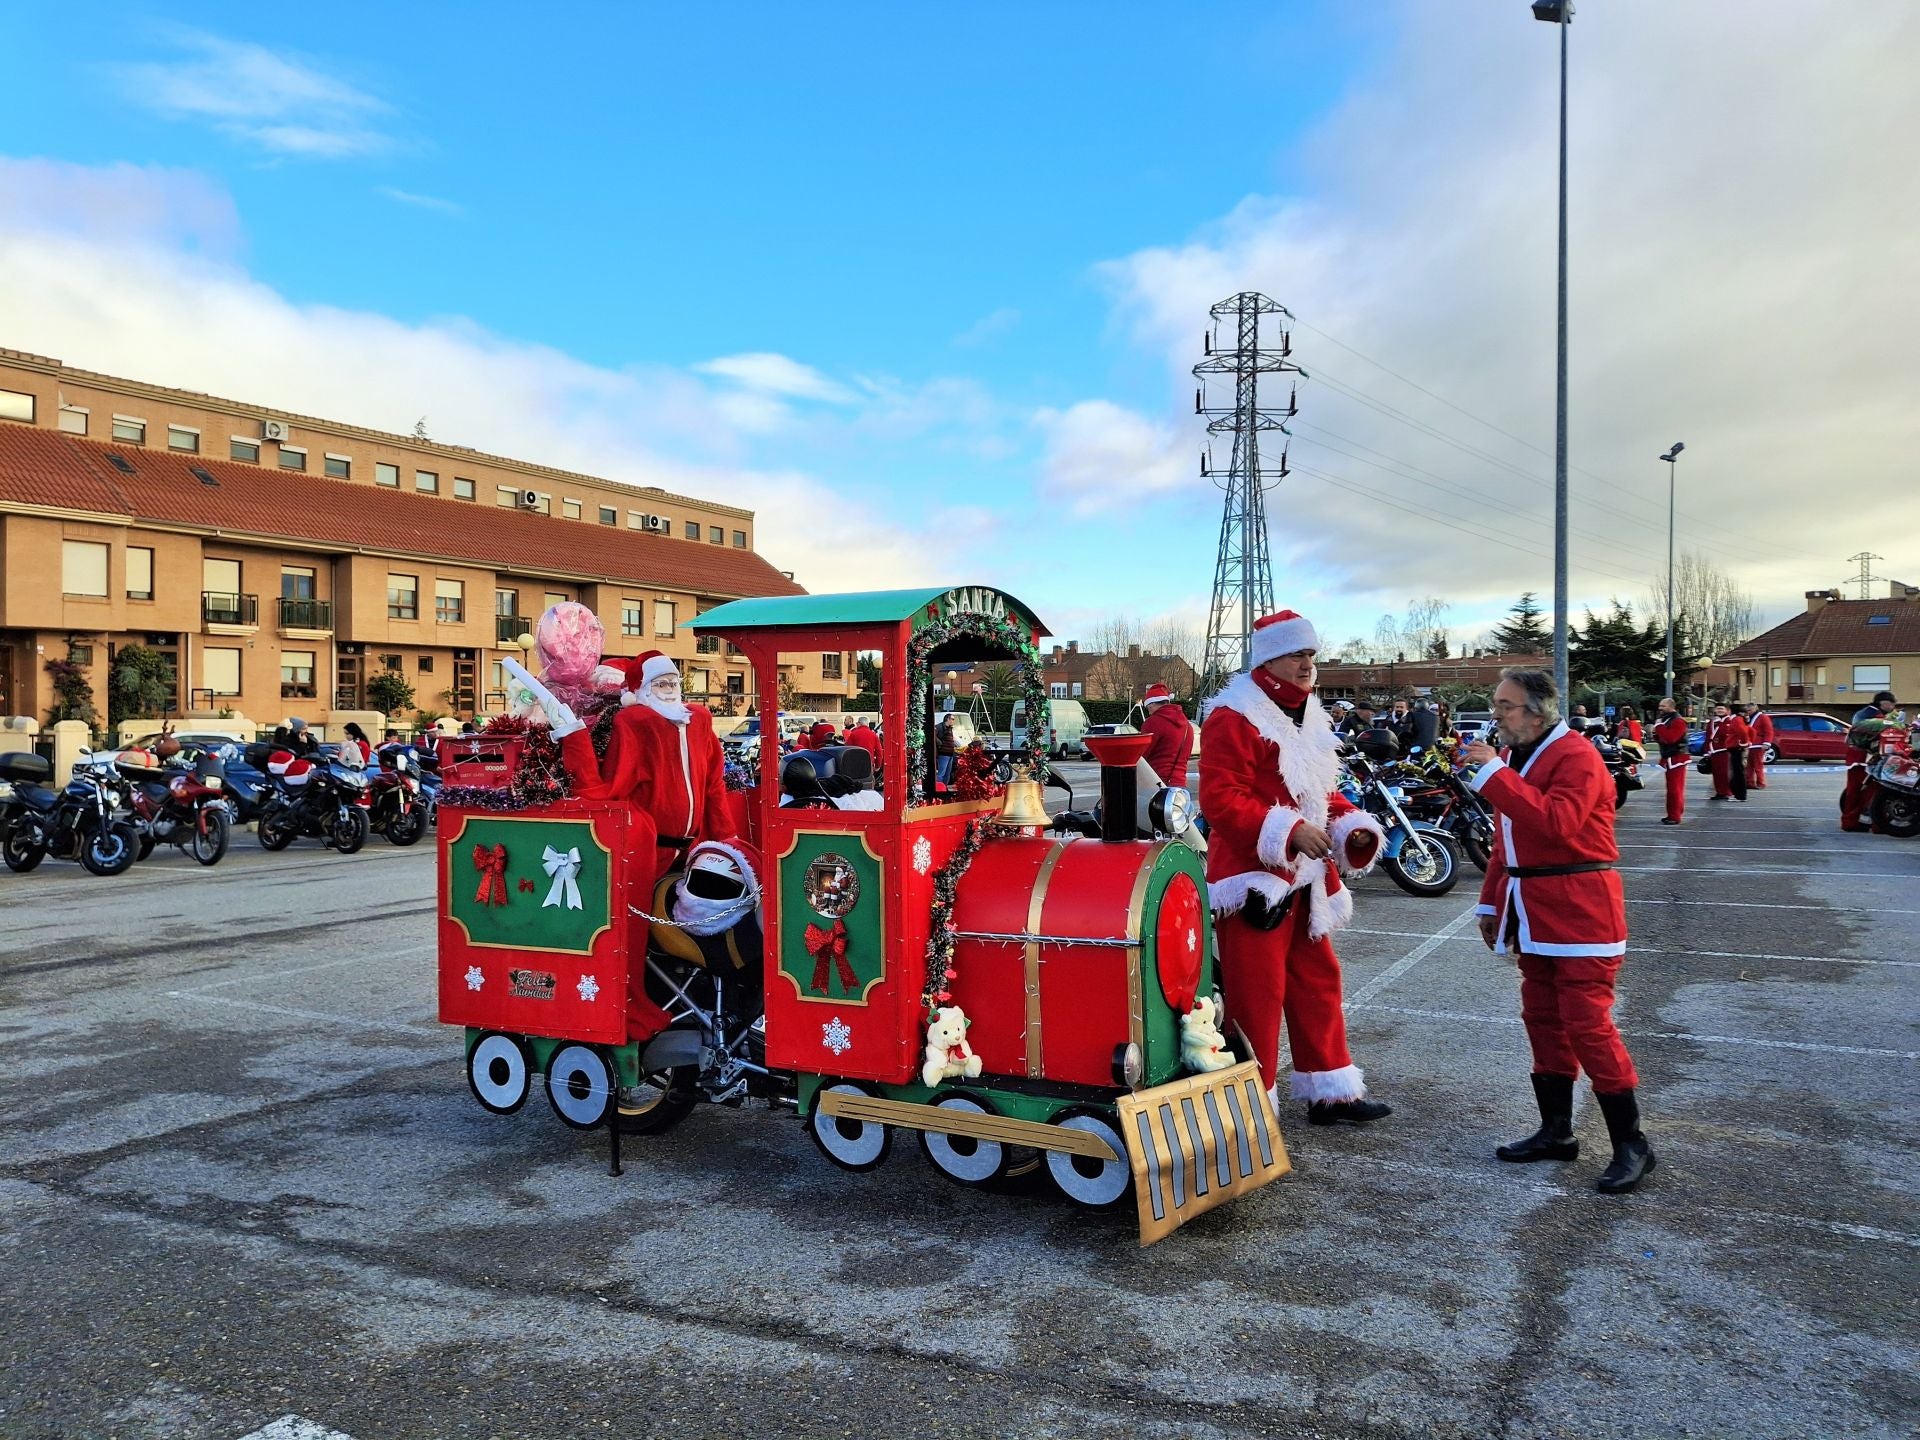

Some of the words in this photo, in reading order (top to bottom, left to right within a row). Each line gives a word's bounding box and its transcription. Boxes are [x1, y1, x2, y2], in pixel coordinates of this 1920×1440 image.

[947, 587, 1005, 619] SANTA
[517, 970, 547, 986] Feliz
[509, 983, 552, 999] Navidad
